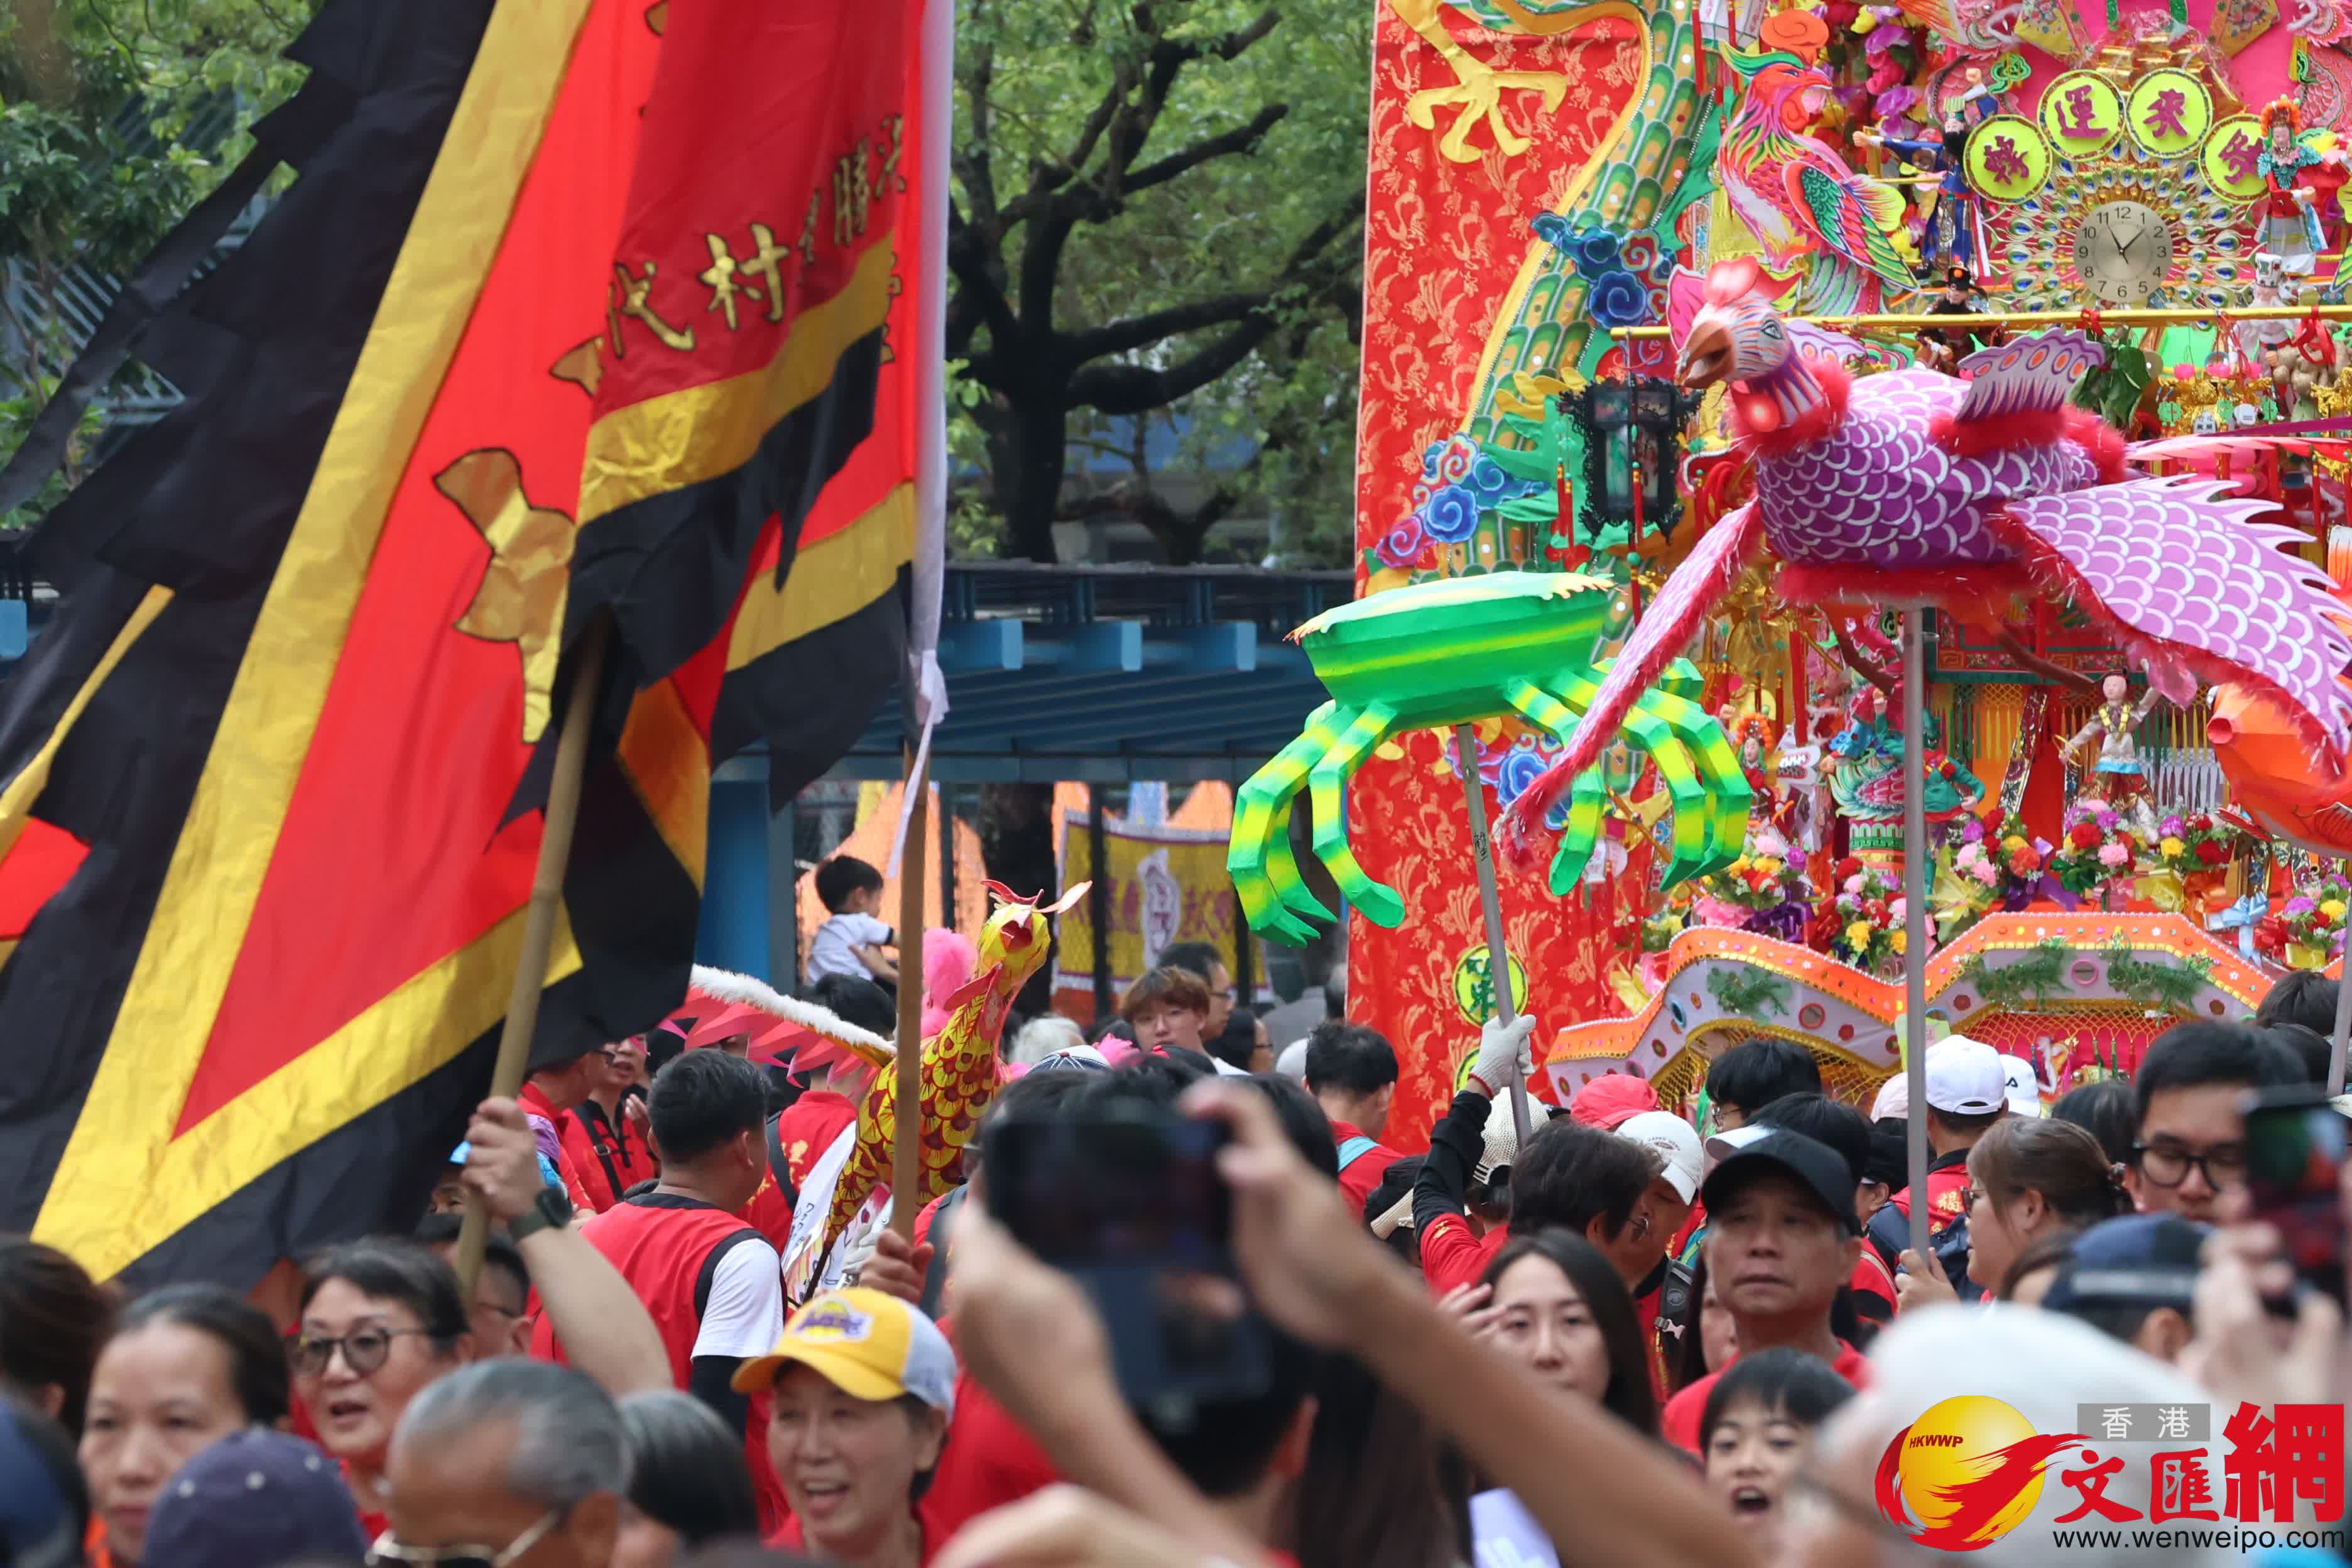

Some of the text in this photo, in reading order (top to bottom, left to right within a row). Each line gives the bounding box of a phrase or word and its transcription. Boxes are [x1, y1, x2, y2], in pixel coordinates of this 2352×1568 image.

[2097, 212, 2109, 224] 11
[2115, 207, 2131, 219] 12
[2082, 227, 2096, 239] 10
[2153, 226, 2164, 237] 2
[2079, 246, 2088, 258] 9
[2157, 246, 2167, 258] 3
[2084, 266, 2094, 278] 8
[2153, 266, 2161, 277] 4
[2098, 281, 2107, 293] 7
[2118, 286, 2127, 297] 6
[2138, 281, 2148, 293] 5
